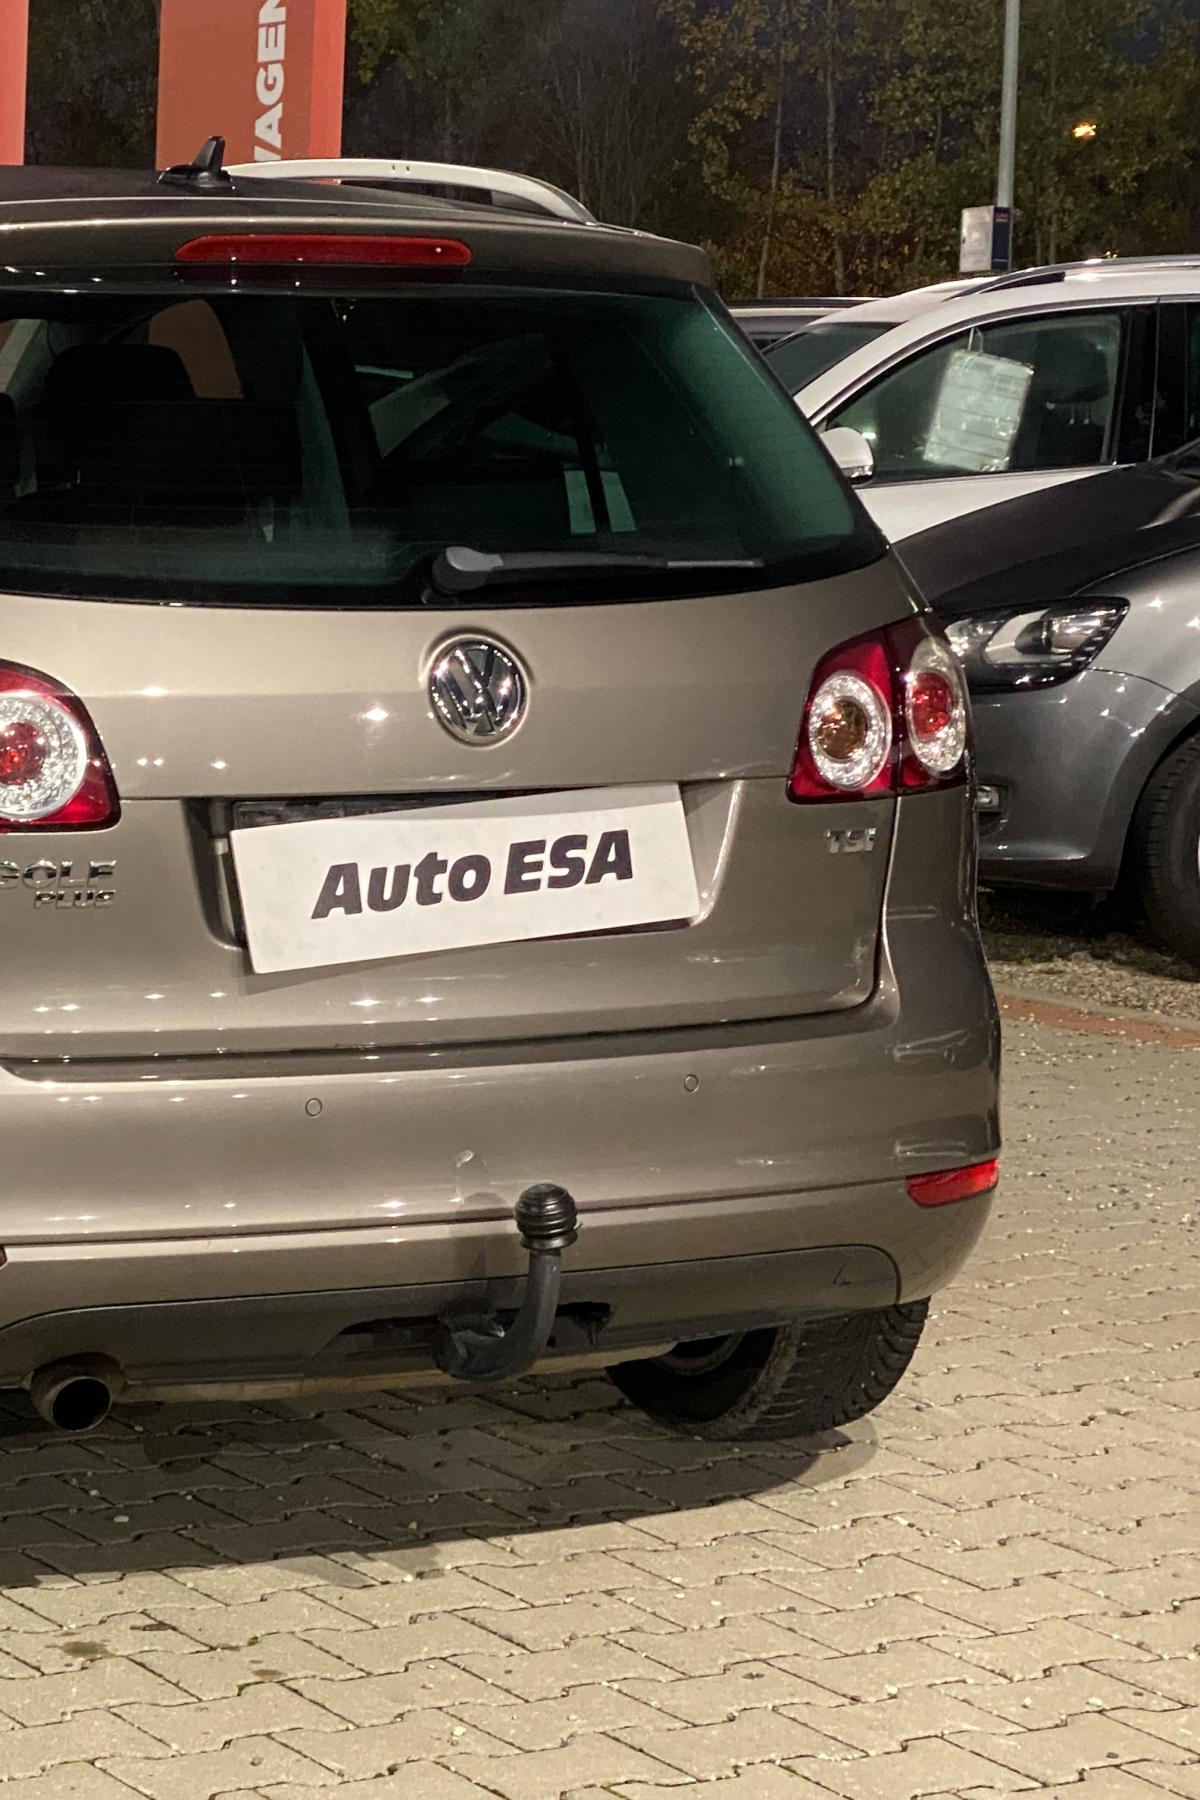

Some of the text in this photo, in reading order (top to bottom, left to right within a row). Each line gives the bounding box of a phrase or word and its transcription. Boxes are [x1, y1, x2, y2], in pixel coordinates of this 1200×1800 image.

[825, 827, 877, 854] TSI
[311, 829, 633, 919] Auto ESA
[33, 890, 116, 910] PLUS
